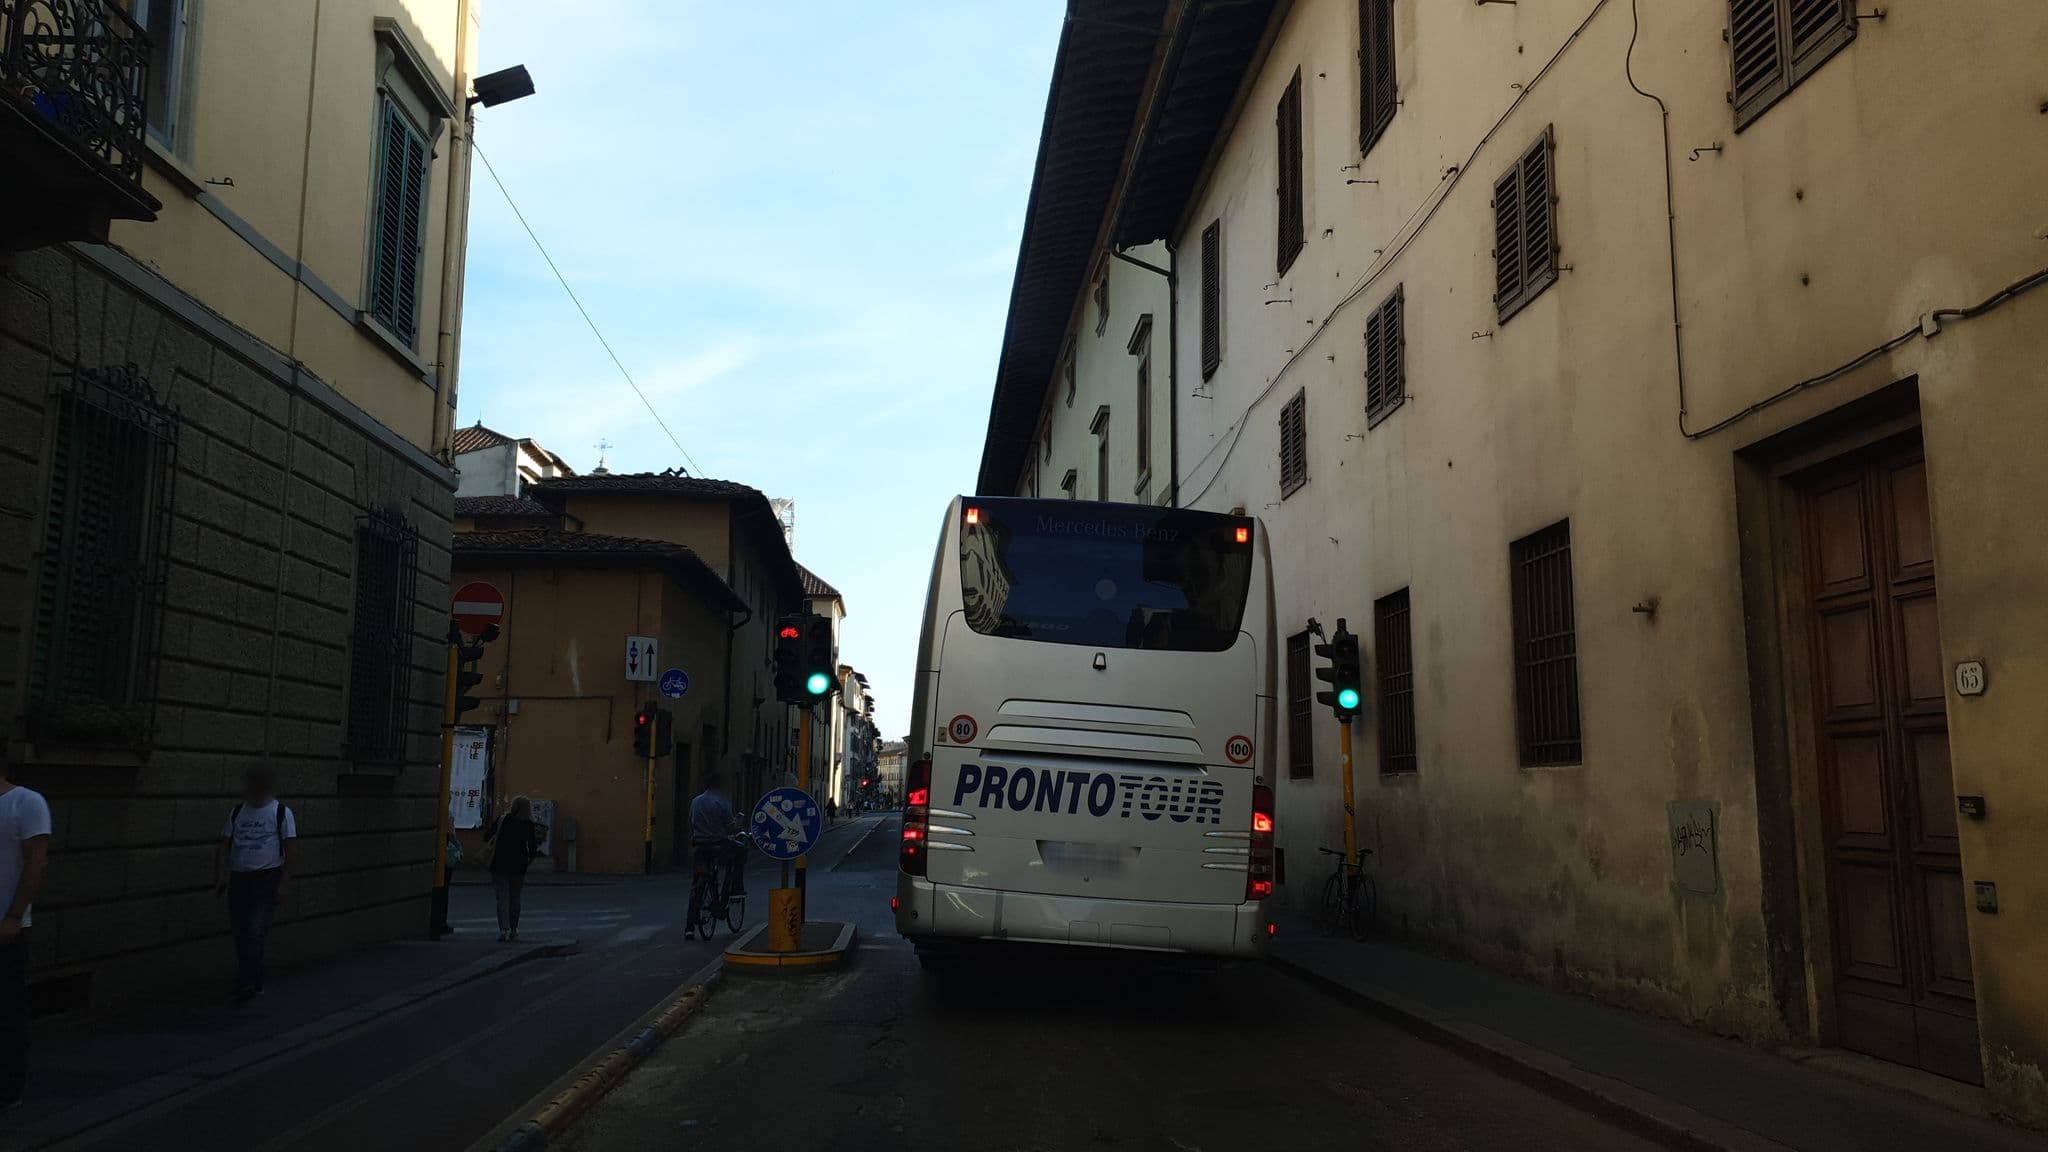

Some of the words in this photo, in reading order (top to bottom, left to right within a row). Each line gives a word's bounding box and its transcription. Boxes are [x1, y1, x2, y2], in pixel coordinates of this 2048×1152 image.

[1961, 667, 1978, 689] 65
[956, 723, 970, 736] 80
[1231, 743, 1248, 756] 100
